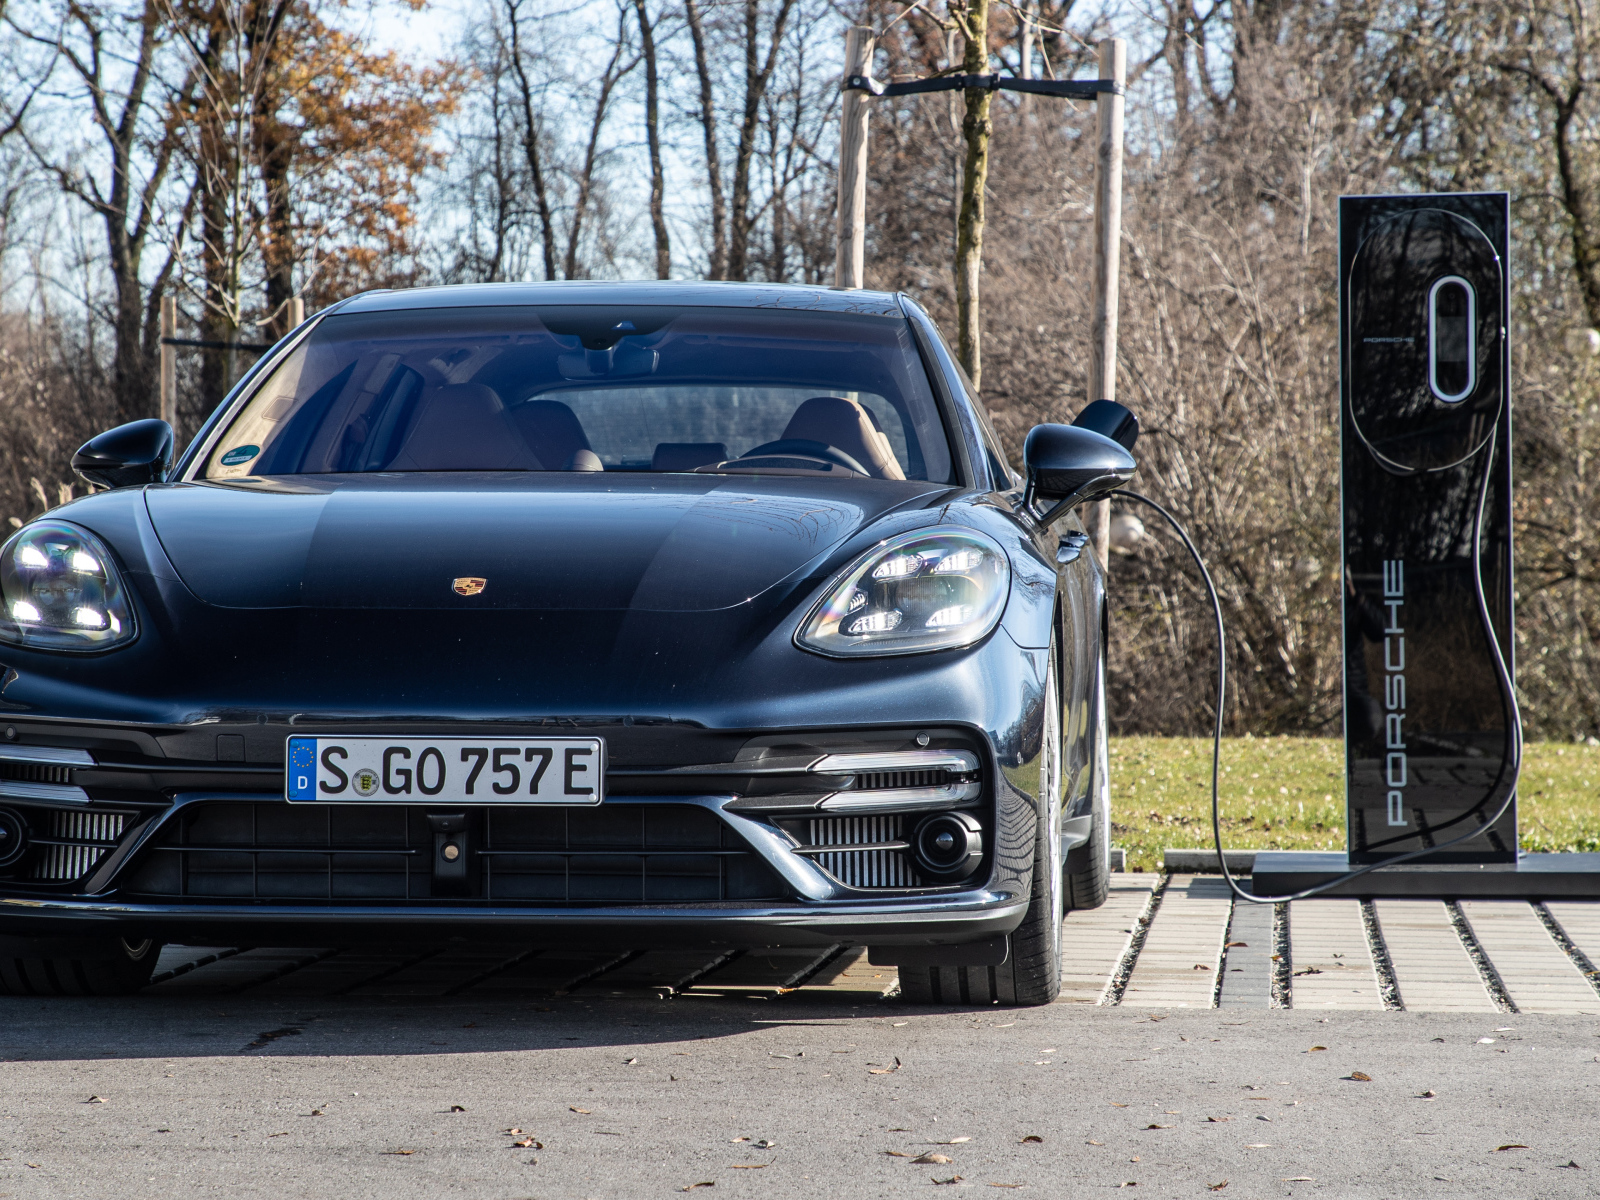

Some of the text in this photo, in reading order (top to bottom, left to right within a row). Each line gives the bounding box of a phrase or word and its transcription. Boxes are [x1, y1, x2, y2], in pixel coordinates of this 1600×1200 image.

[1384, 560, 1408, 826] PORSCHE
[297, 776, 308, 790] D
[319, 746, 349, 794] S
[382, 746, 446, 795] GO
